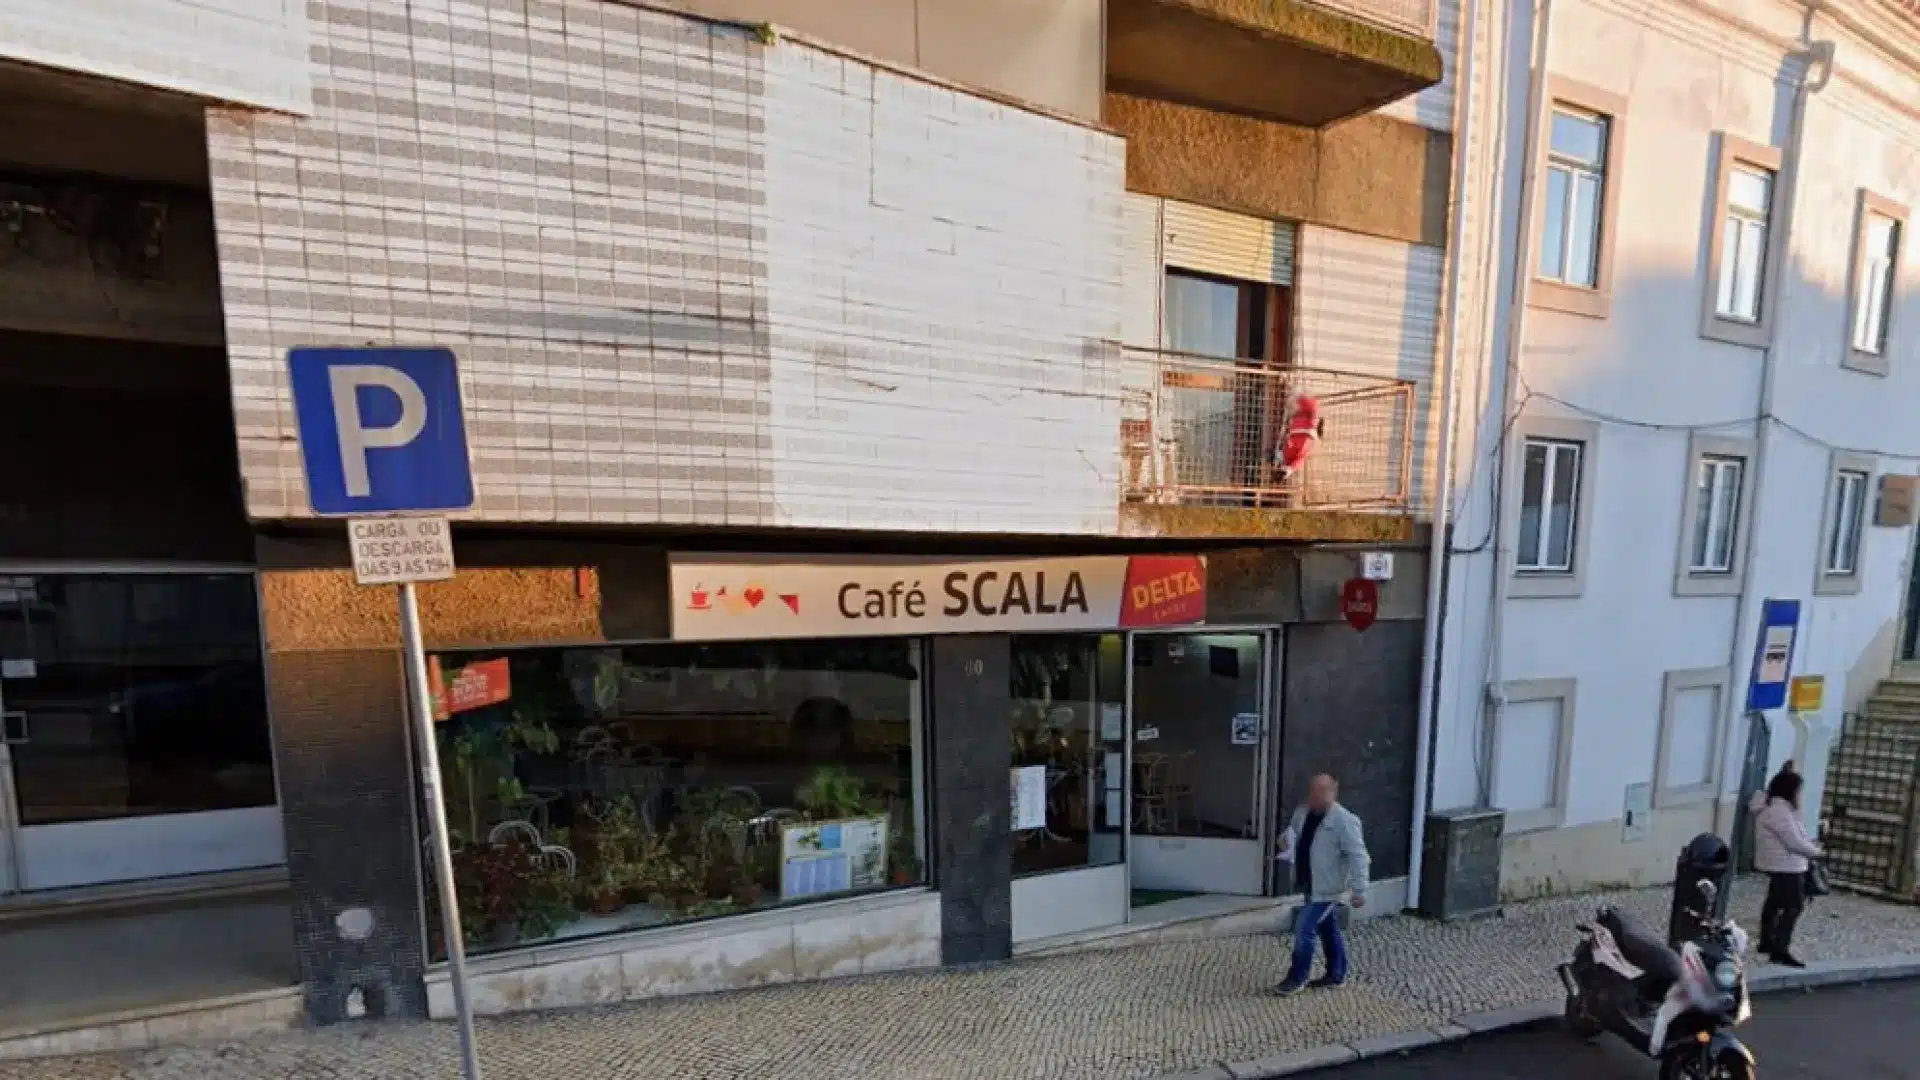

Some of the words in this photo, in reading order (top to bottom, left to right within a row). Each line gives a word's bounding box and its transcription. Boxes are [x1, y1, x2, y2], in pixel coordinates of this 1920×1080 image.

[328, 365, 427, 497] P
[354, 522, 408, 539] CARGA
[417, 521, 440, 536] OU
[359, 540, 444, 557] DESCARGA
[359, 560, 389, 576] DAS
[837, 579, 926, 619] Café
[943, 570, 1089, 617] SCALA
[1132, 571, 1201, 609] DELTA
